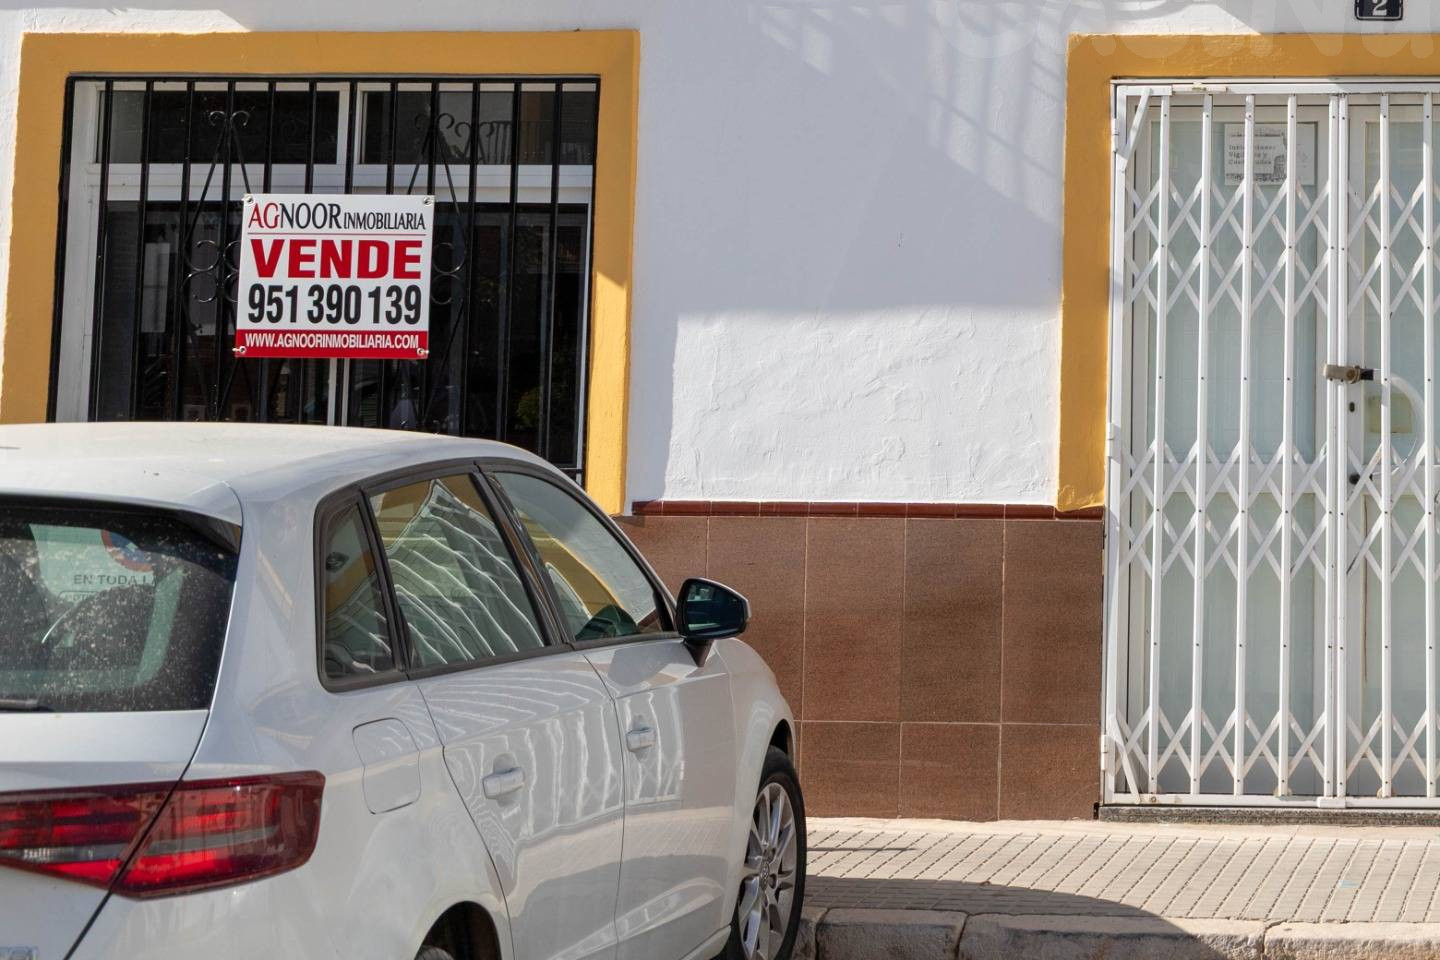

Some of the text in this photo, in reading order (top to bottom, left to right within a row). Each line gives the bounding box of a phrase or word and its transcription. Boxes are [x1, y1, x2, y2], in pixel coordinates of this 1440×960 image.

[248, 203, 426, 230] AGNOOR INMOBILIARIA
[251, 239, 423, 279] VENDE
[248, 283, 422, 325] 951 390 139
[245, 332, 419, 349] WWW.AGNOORINMOBILIARIA.COM
[74, 574, 93, 585] EN
[97, 575, 138, 586] TODA
